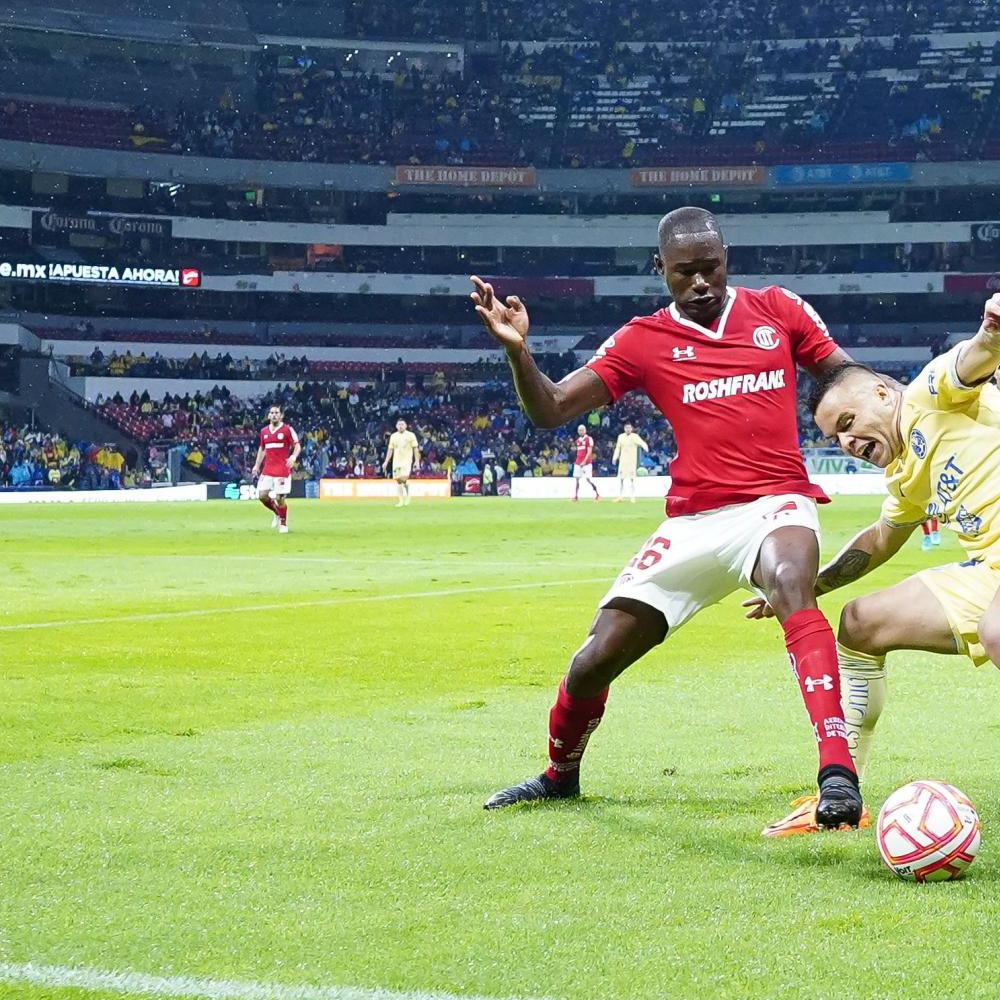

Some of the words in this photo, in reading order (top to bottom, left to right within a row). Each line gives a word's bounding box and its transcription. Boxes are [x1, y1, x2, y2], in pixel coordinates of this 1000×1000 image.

[404, 168, 434, 182] THE
[437, 168, 477, 182] HOME
[481, 169, 527, 183] DEPOT
[640, 170, 667, 182] THE
[671, 169, 709, 182] HOME
[712, 169, 757, 181] DEPOT
[41, 212, 96, 232] Corona
[109, 216, 163, 235] Corona
[121, 267, 180, 282] AHORA!
[682, 368, 786, 404] ROSHFRANS
